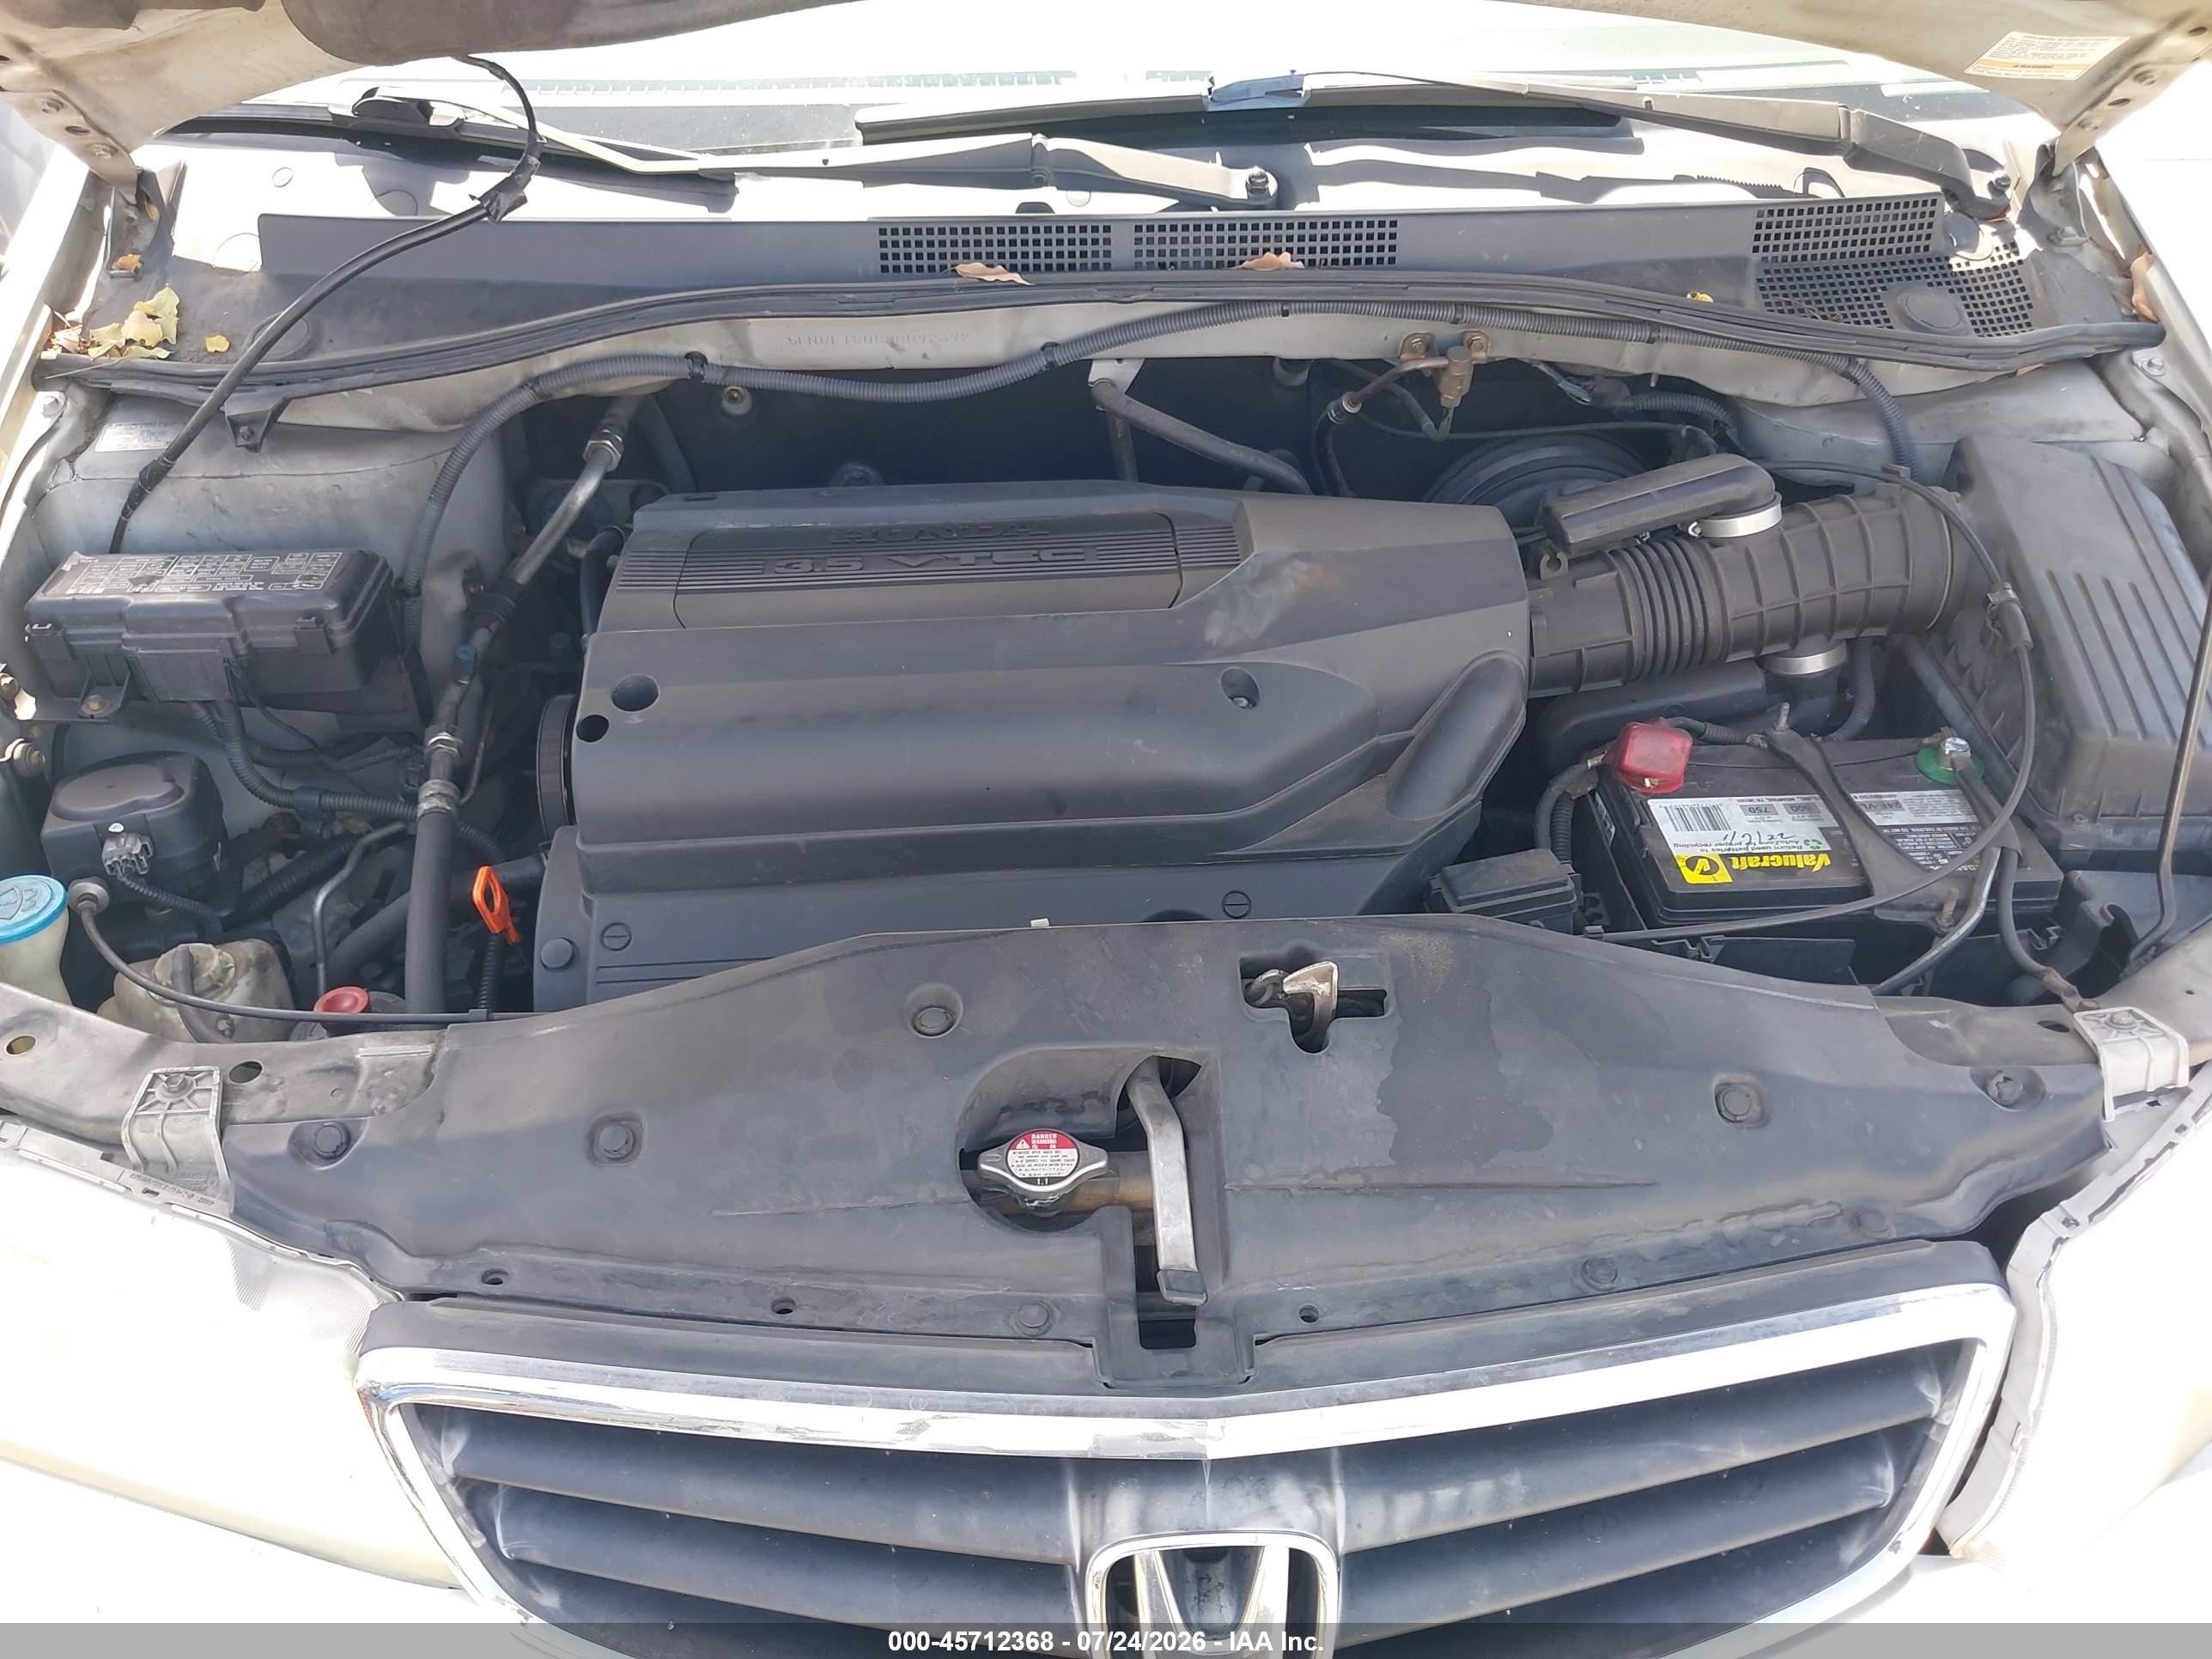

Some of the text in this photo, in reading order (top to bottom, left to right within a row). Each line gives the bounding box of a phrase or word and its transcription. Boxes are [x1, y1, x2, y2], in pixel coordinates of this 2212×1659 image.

[830, 523, 1051, 544] HONDA
[775, 548, 1086, 574] 3.5 VTEC
[1731, 853, 1832, 872] Valucraft
